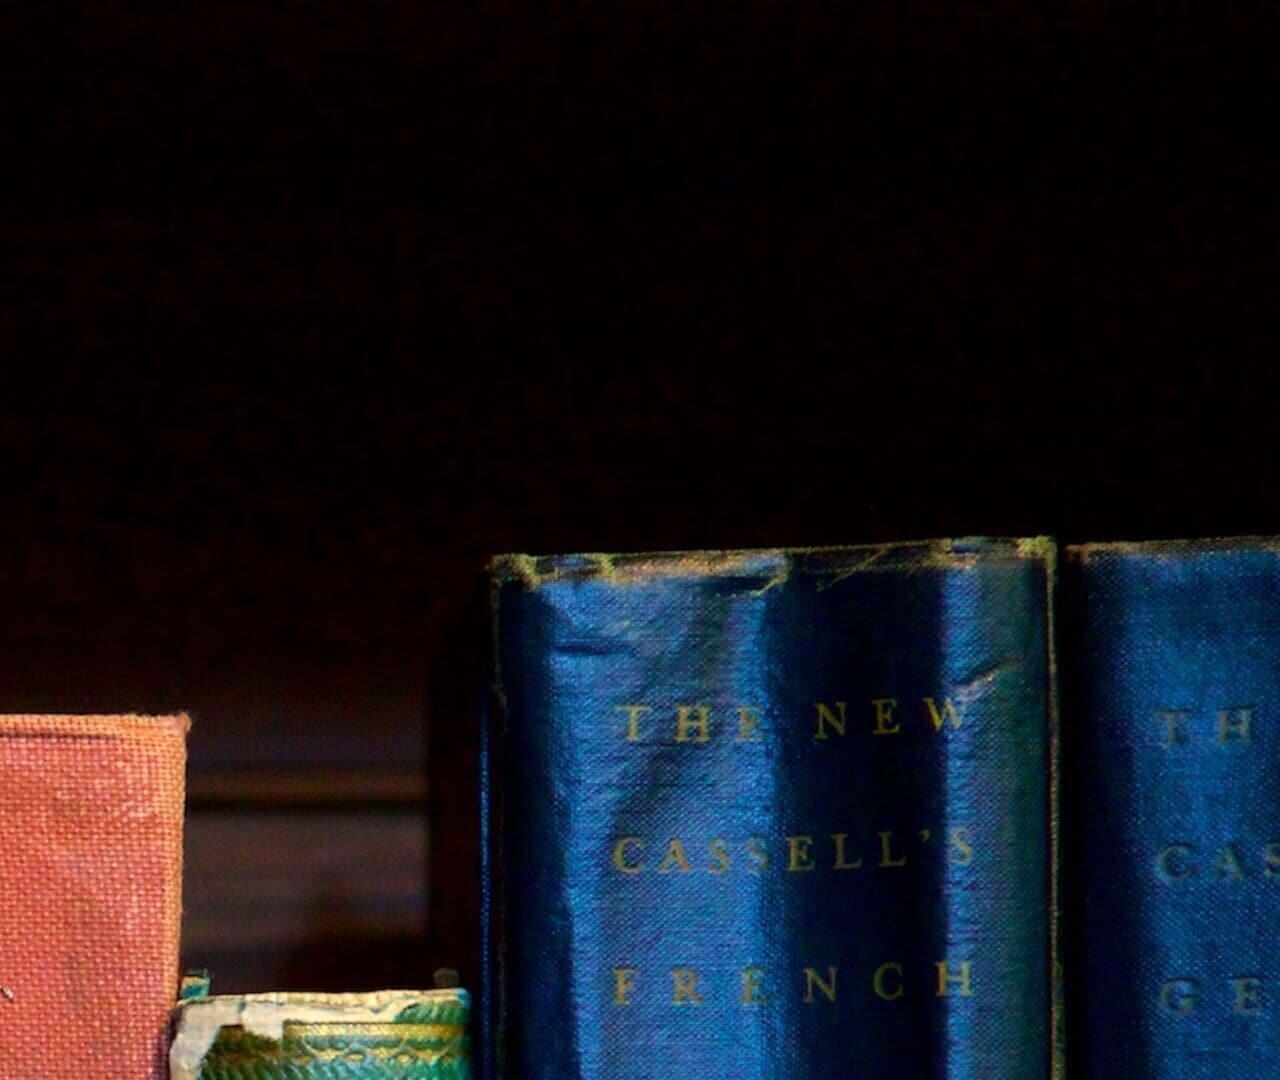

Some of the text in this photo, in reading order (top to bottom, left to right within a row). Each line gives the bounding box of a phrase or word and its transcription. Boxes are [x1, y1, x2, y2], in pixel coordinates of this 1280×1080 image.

[617, 699, 966, 742] THE NEW
[612, 828, 973, 874] CASSELL'S
[612, 961, 974, 1006] FRENCH
